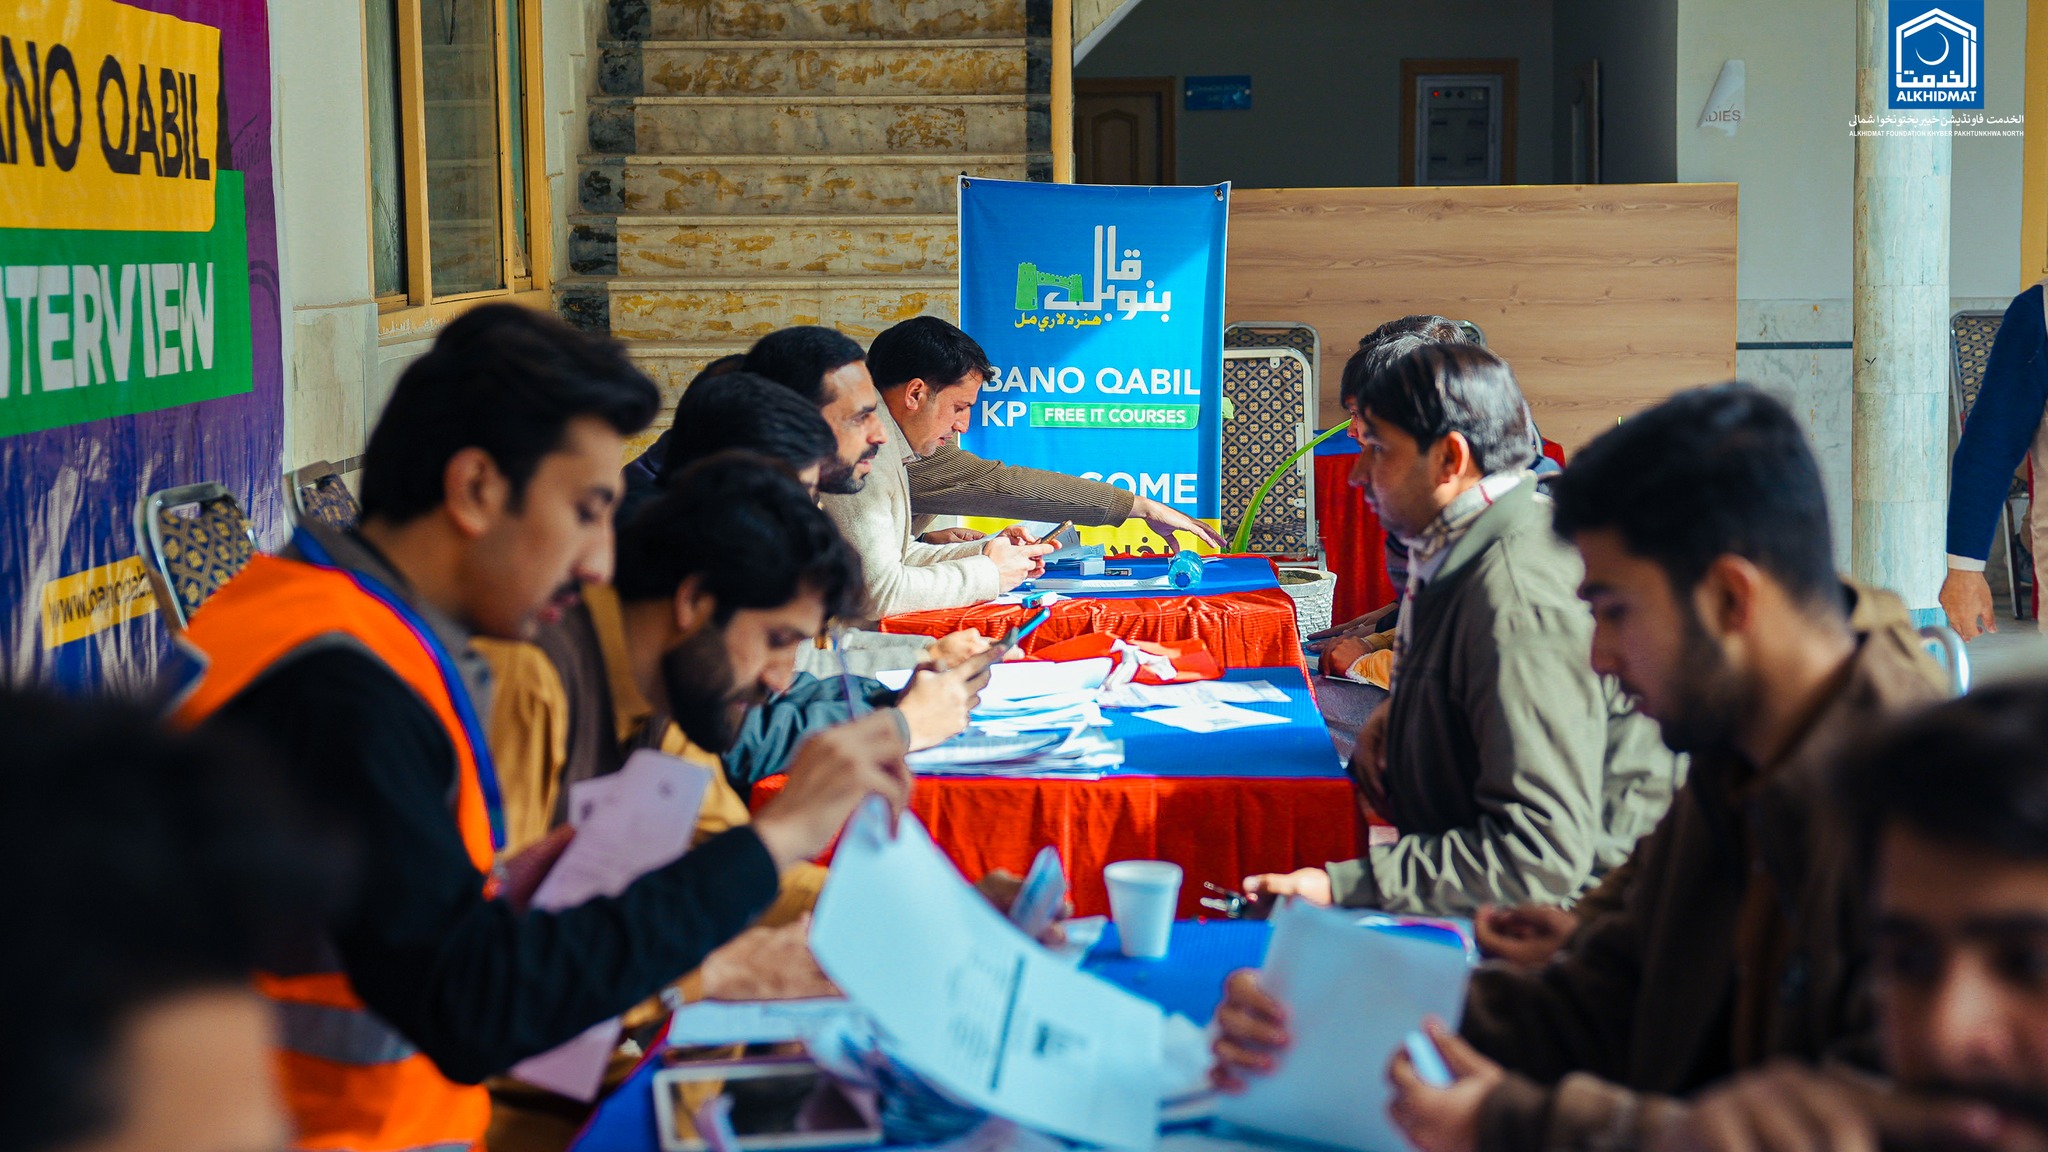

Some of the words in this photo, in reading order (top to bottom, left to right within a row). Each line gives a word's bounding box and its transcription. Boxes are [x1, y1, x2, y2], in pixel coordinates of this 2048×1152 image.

[0, 35, 81, 172] NO
[96, 54, 210, 180] QABIL
[1705, 110, 1741, 121] DIES
[982, 366, 1085, 393] BANO
[1095, 367, 1200, 395] QABIL
[982, 400, 1027, 427] KP
[1044, 407, 1085, 422] FREE
[1090, 408, 1104, 422] IT
[1108, 408, 1186, 424] COURSES
